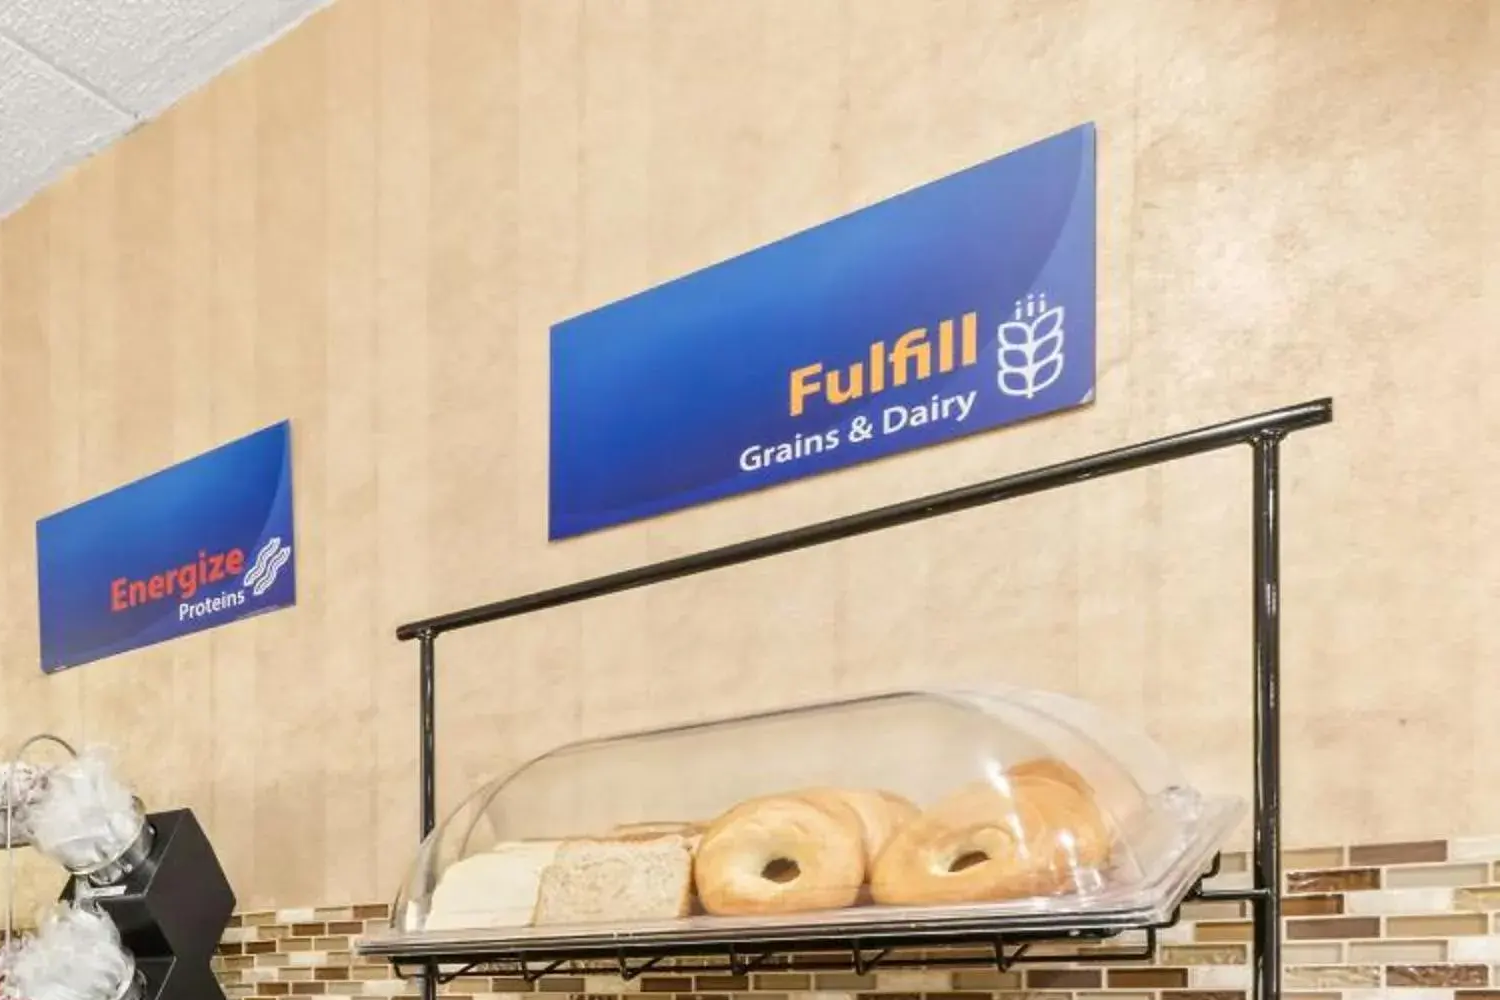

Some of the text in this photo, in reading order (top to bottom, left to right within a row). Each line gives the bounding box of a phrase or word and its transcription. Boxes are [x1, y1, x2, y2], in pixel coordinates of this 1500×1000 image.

[789, 311, 977, 417] Fulfill
[739, 390, 977, 471] Grains & Dairy
[110, 547, 244, 612] Energize
[179, 589, 245, 621] Proteins
